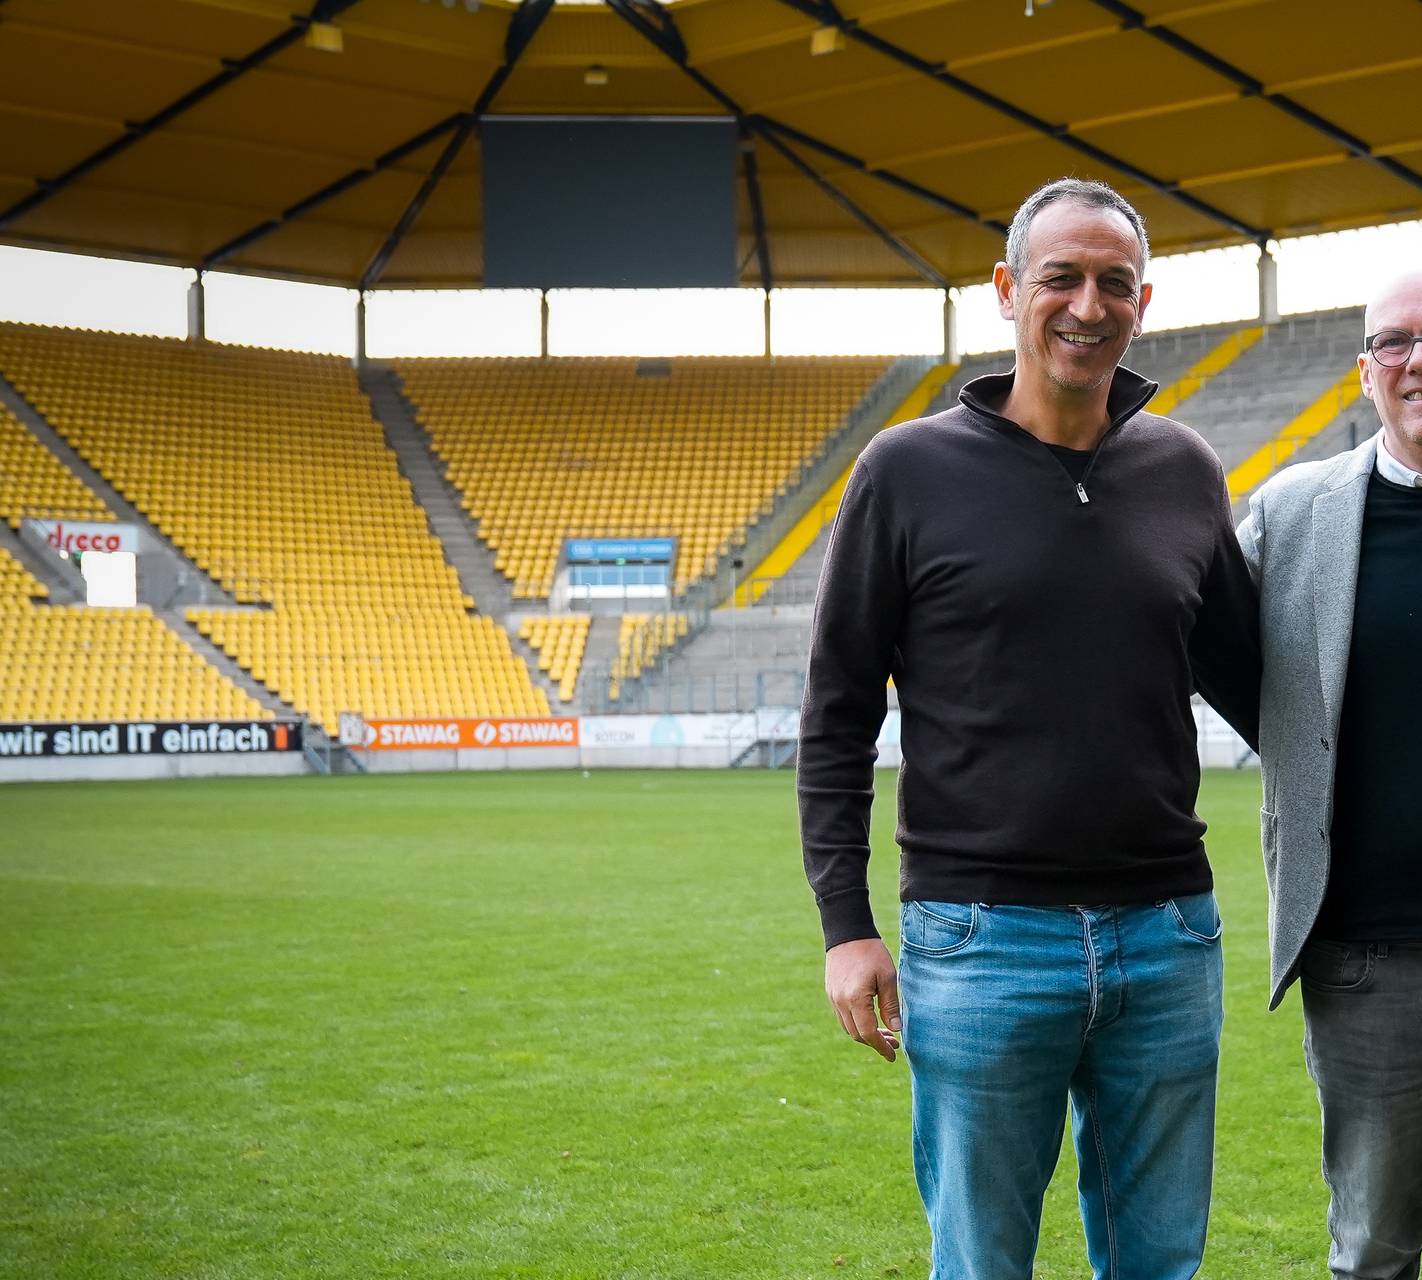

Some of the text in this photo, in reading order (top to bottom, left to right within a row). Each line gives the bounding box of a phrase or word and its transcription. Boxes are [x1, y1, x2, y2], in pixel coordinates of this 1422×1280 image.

[0, 722, 269, 756] wir sind IT einfach
[379, 724, 460, 744] STAWAG
[500, 722, 574, 742] STAWAG
